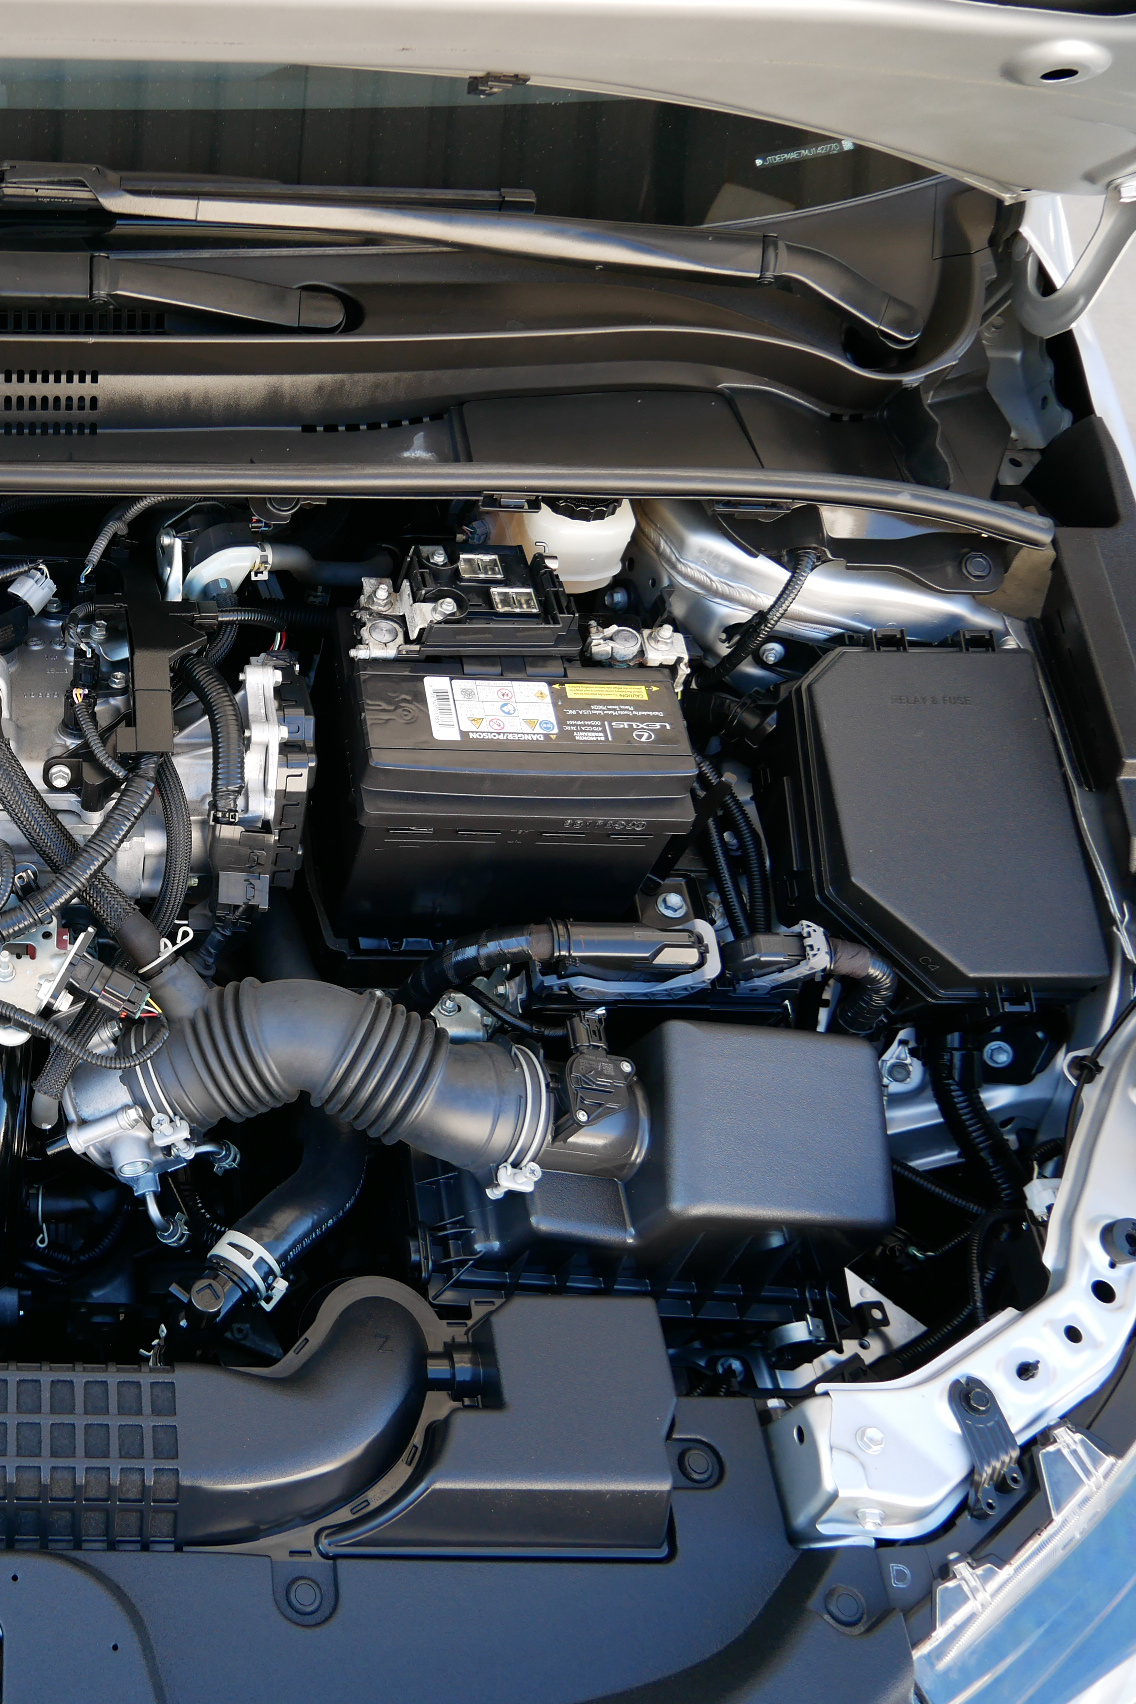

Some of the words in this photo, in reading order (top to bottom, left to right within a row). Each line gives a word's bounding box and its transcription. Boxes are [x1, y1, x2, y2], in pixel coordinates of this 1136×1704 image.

[890, 695, 928, 704] RELAY
[942, 696, 972, 705] FUSE
[611, 721, 671, 730] LEXUS
[468, 732, 545, 741] DANGER/POISON
[889, 1563, 912, 1588] D
